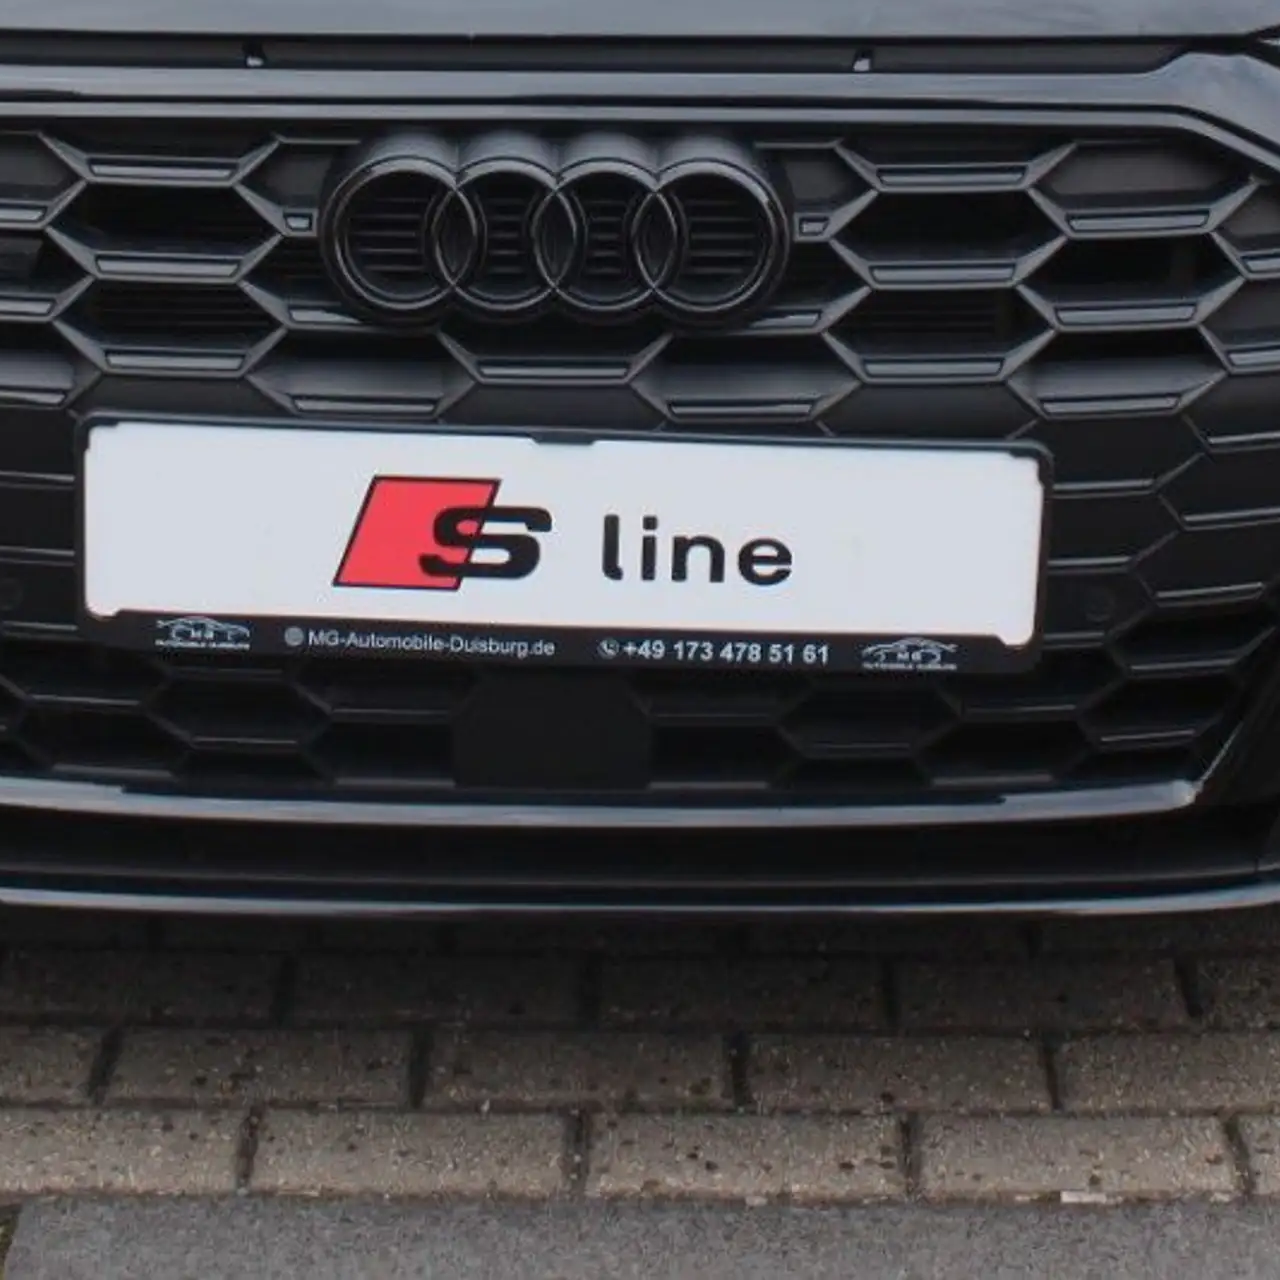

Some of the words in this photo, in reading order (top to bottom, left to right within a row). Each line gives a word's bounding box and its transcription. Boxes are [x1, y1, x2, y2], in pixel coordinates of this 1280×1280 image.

[419, 505, 553, 579] S
[601, 514, 793, 586] line
[307, 628, 556, 659] MG-Automobile-Duisburg.de
[622, 638, 666, 660] +49
[673, 640, 714, 661] 173
[719, 641, 762, 663] 478
[769, 644, 795, 664] 51
[802, 644, 830, 665] 61
